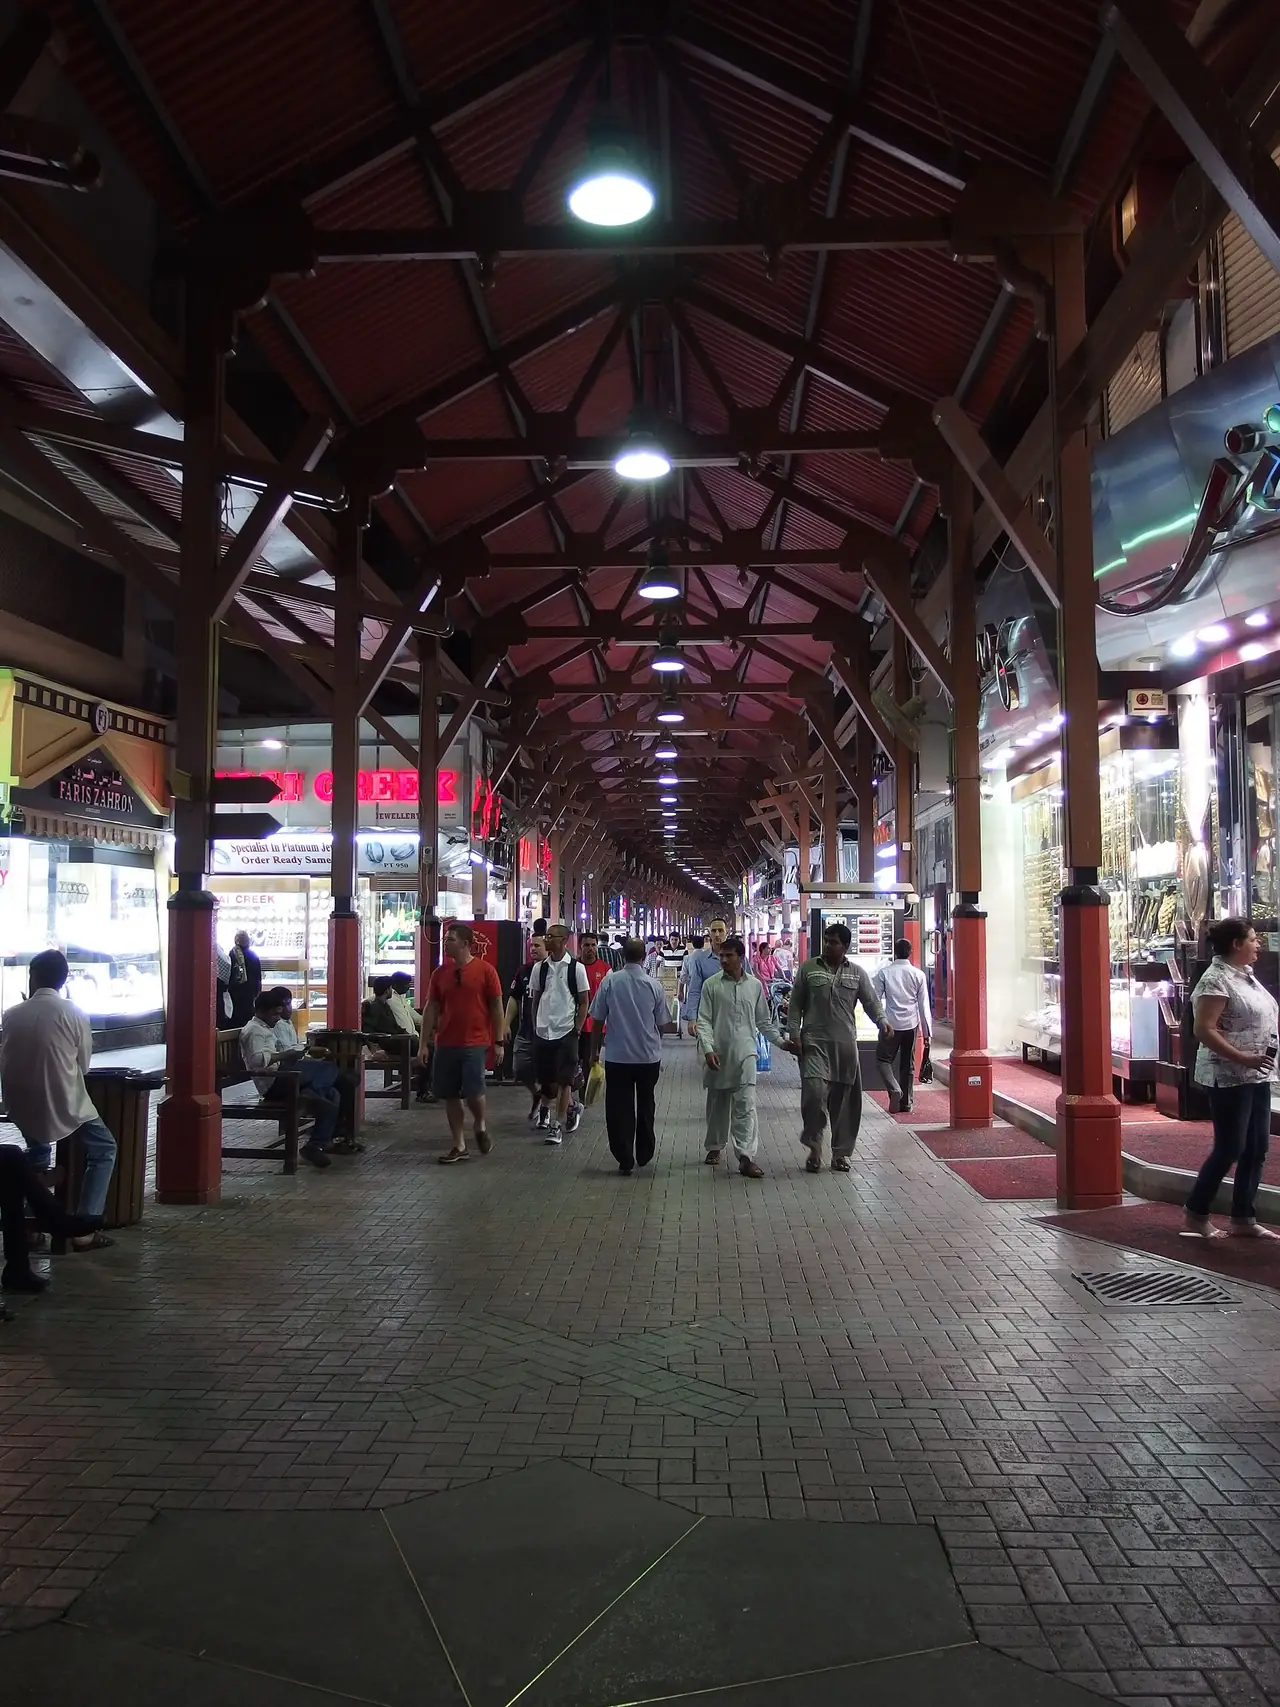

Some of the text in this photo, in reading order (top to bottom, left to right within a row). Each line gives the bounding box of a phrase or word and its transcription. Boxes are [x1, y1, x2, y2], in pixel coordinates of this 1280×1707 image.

[59, 781, 134, 813] FARIS ZAHRON
[376, 812, 420, 820] JEWELLERY
[231, 842, 269, 855] Specialist
[282, 842, 319, 853] Platinum
[241, 856, 332, 866] Order Ready Same
[236, 895, 274, 903] CREEK
